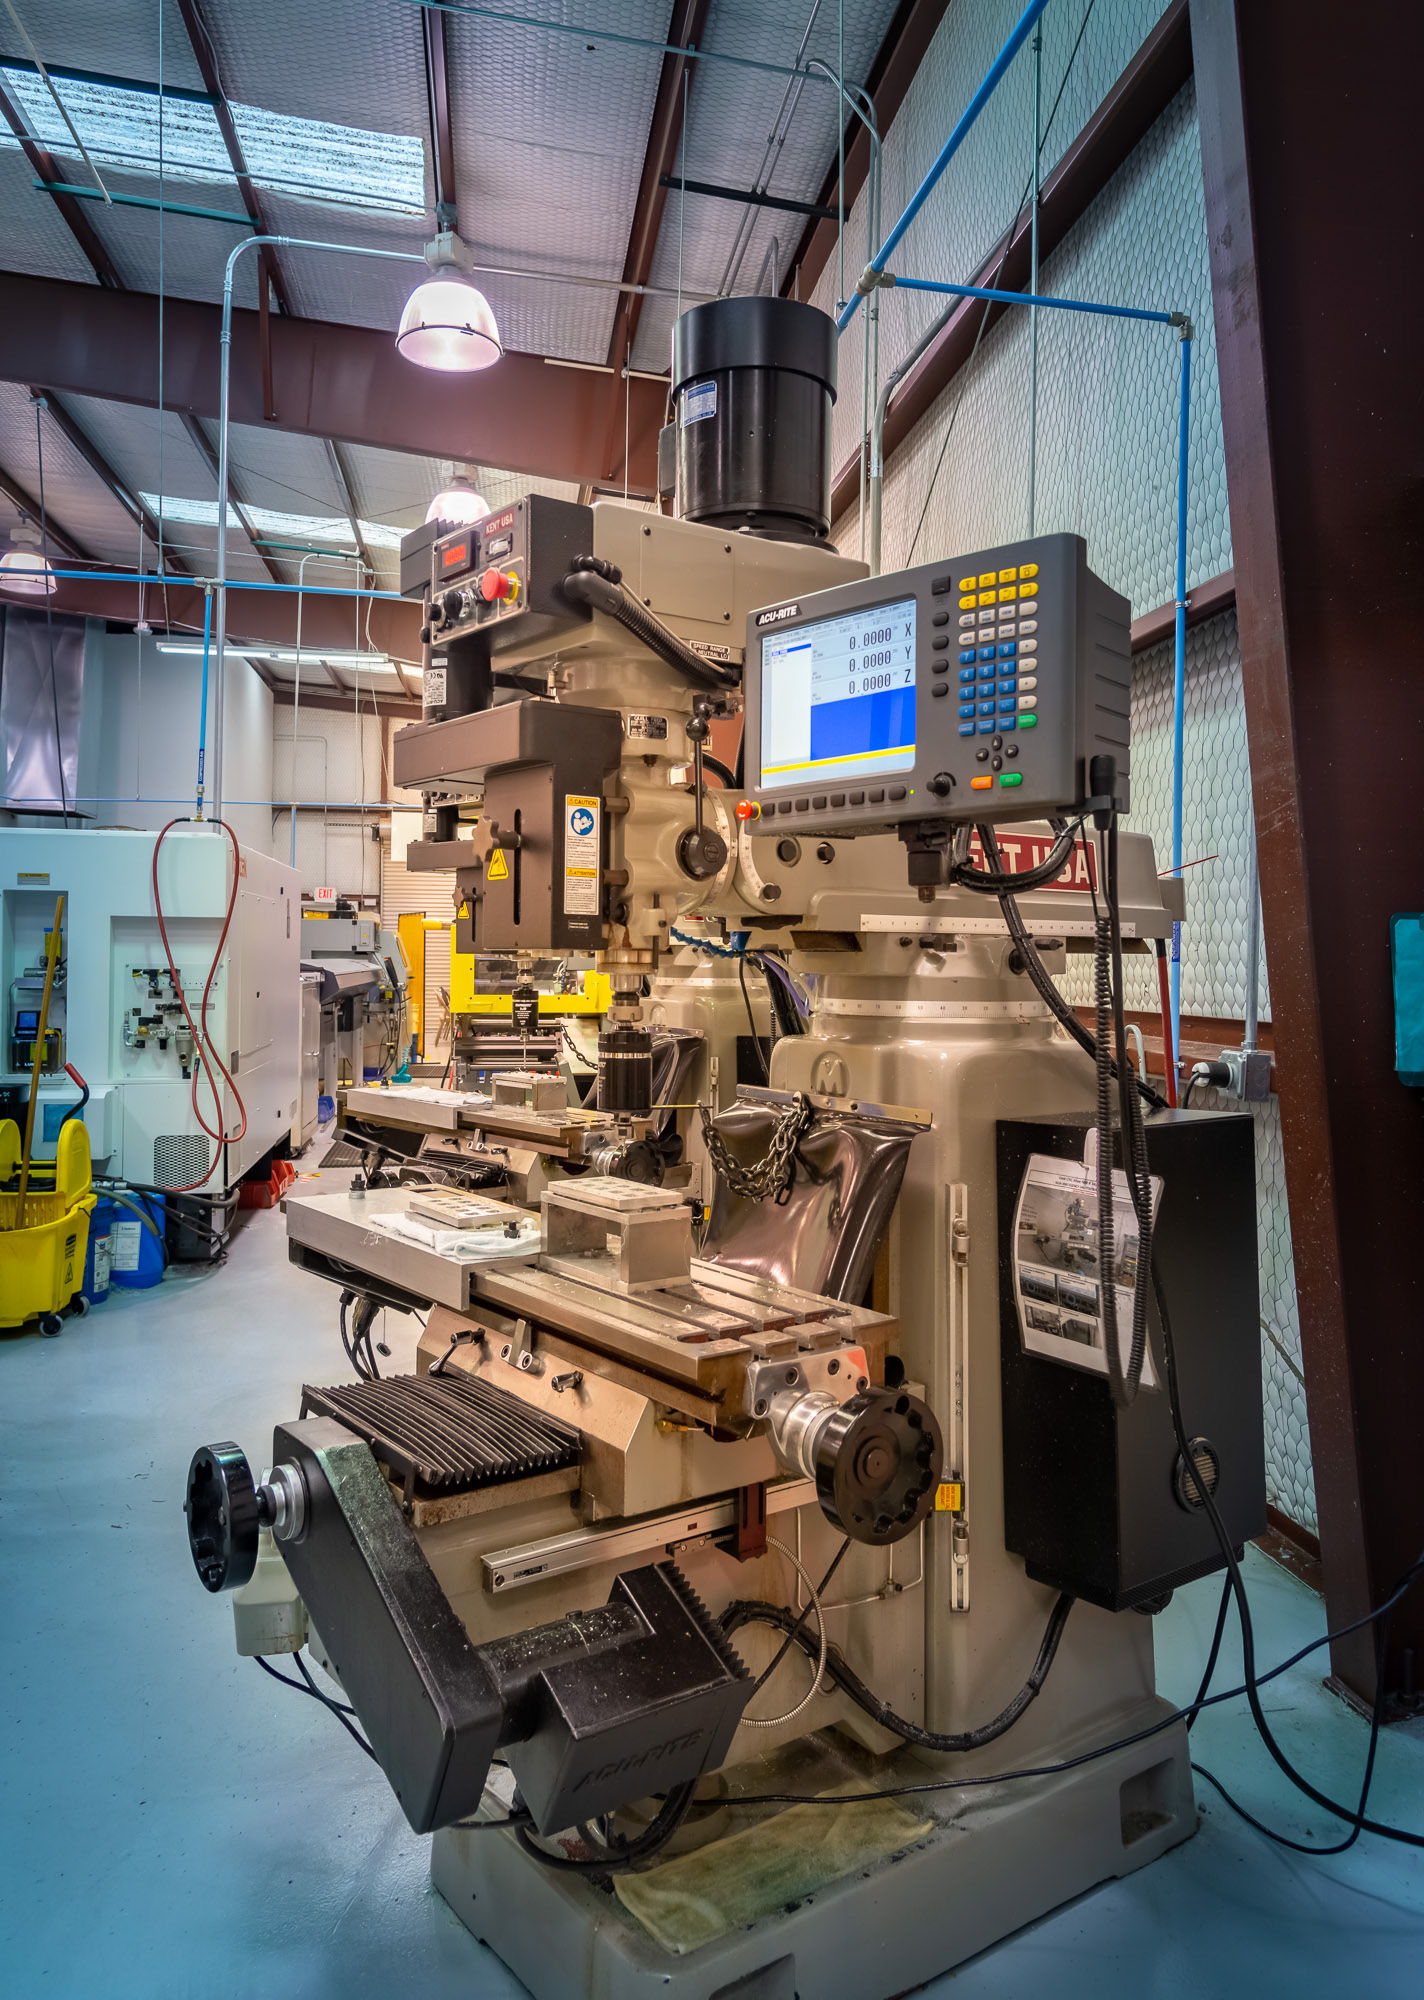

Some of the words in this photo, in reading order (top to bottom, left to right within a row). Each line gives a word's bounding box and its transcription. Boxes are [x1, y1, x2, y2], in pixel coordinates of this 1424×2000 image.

[485, 519, 501, 534] KENT
[502, 512, 513, 528] USA
[758, 605, 798, 625] ACU-RITE
[849, 627, 892, 650] 0.0000
[905, 622, 912, 637] X
[693, 643, 708, 651] SPEED
[710, 645, 725, 653] RANGE
[698, 649, 719, 657] NEUTRAL
[849, 650, 891, 672] 0.0000
[905, 645, 912, 660] Y
[849, 673, 891, 695] 0.0000
[904, 669, 911, 684] Z
[318, 888, 333, 899] EXIT
